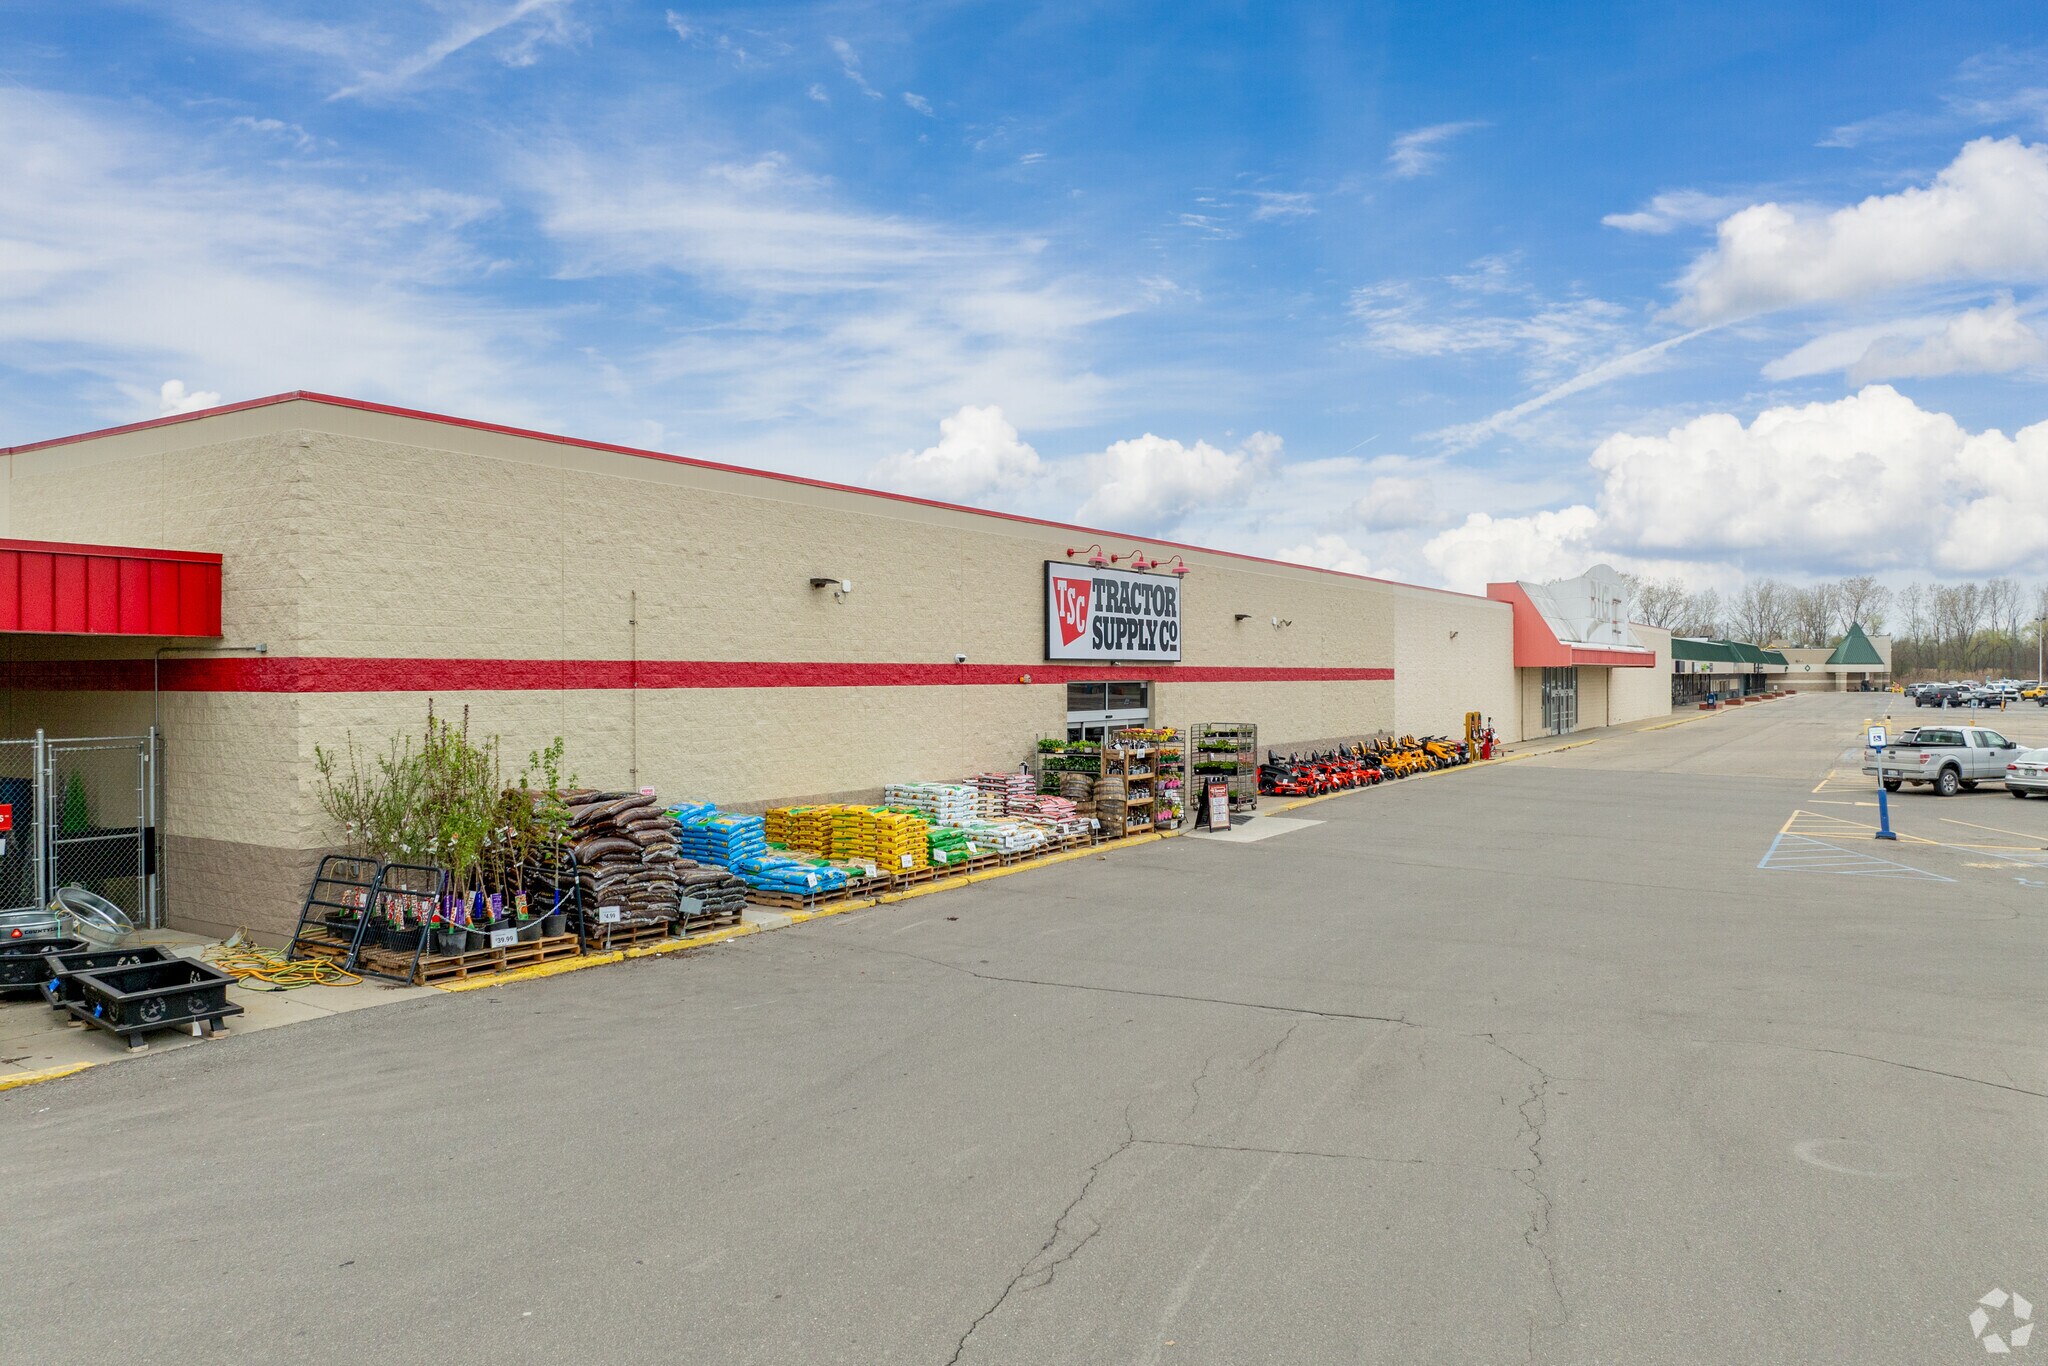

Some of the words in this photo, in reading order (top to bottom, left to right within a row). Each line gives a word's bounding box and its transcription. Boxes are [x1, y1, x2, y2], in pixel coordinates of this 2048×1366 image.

[1057, 579, 1085, 633] TSC
[1092, 577, 1177, 618] TRACTOR
[1092, 615, 1158, 652] SUPPLY
